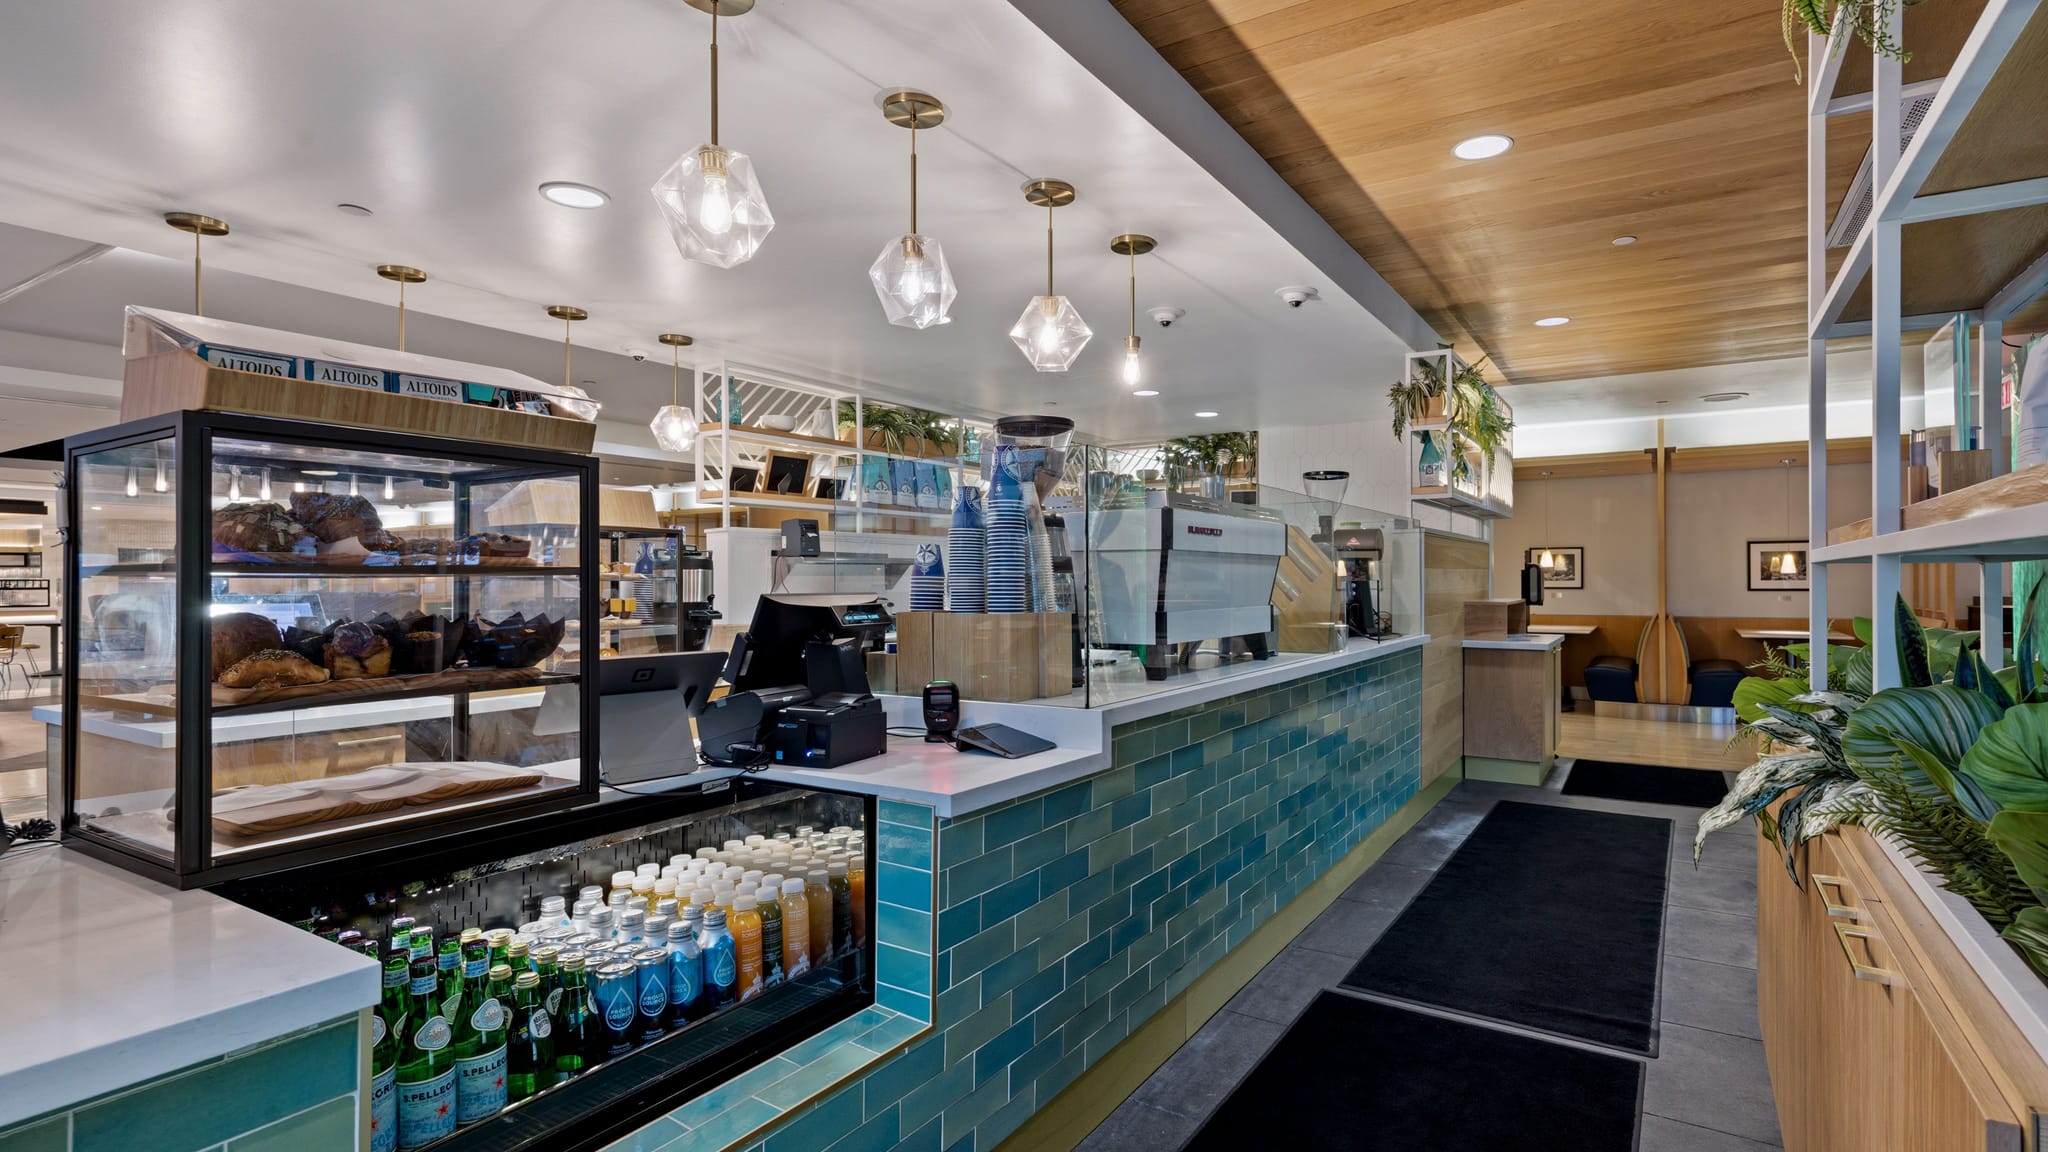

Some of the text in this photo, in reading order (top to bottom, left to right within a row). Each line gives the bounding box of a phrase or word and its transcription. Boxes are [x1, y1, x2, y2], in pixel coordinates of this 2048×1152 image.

[217, 356, 283, 377] ALTOIDS
[322, 367, 378, 387] ALTOIDS
[406, 380, 458, 397] ALTOIDS
